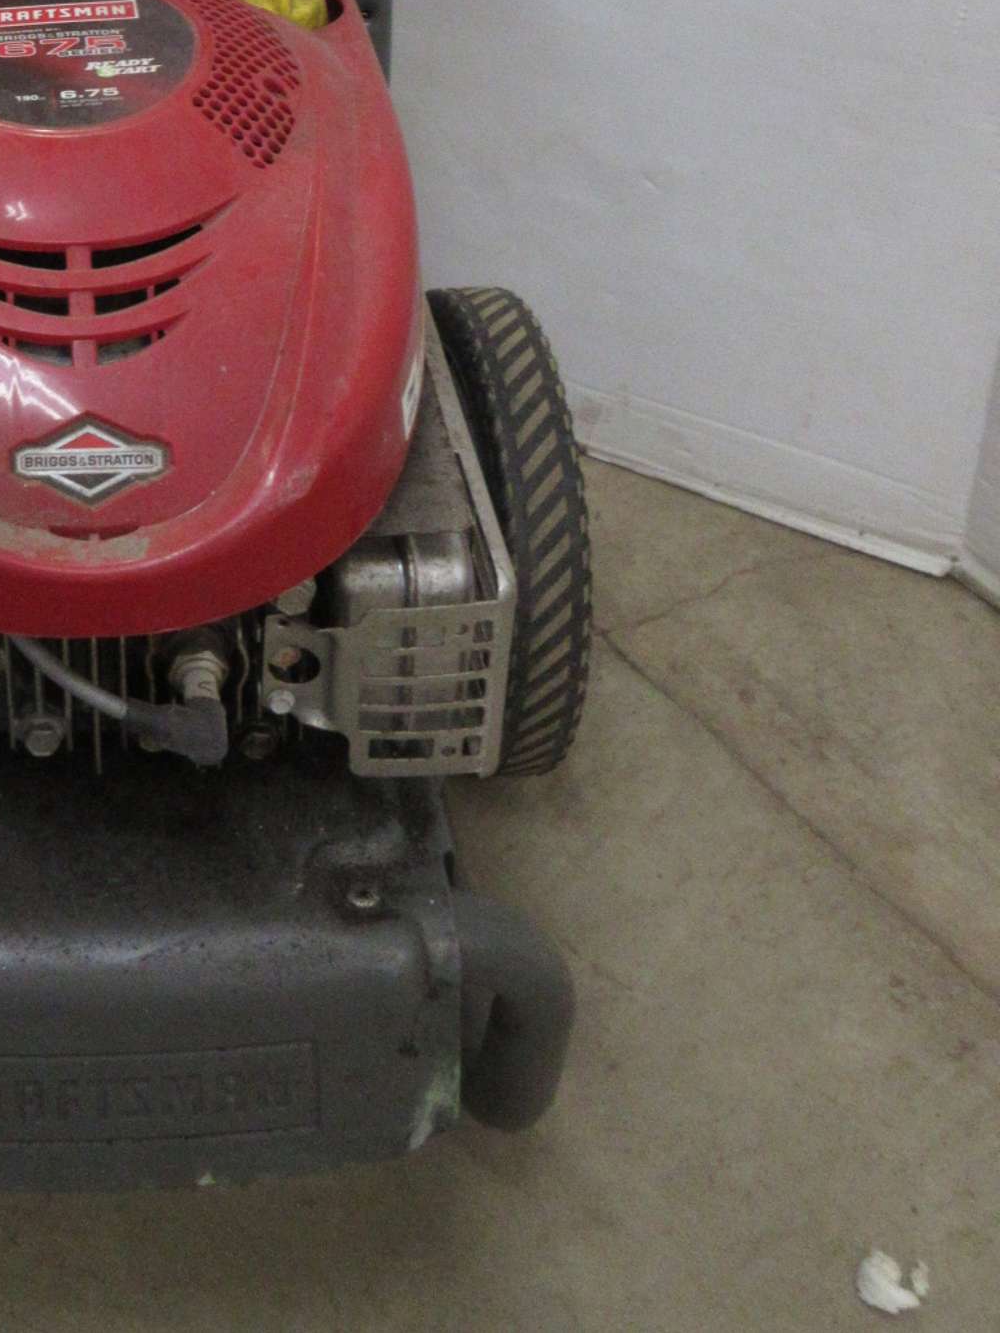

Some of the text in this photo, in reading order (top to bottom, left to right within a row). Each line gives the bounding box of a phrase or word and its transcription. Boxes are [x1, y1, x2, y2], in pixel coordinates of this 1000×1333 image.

[85, 57, 155, 71] READY
[98, 63, 162, 77] START
[59, 86, 121, 100] 6.75
